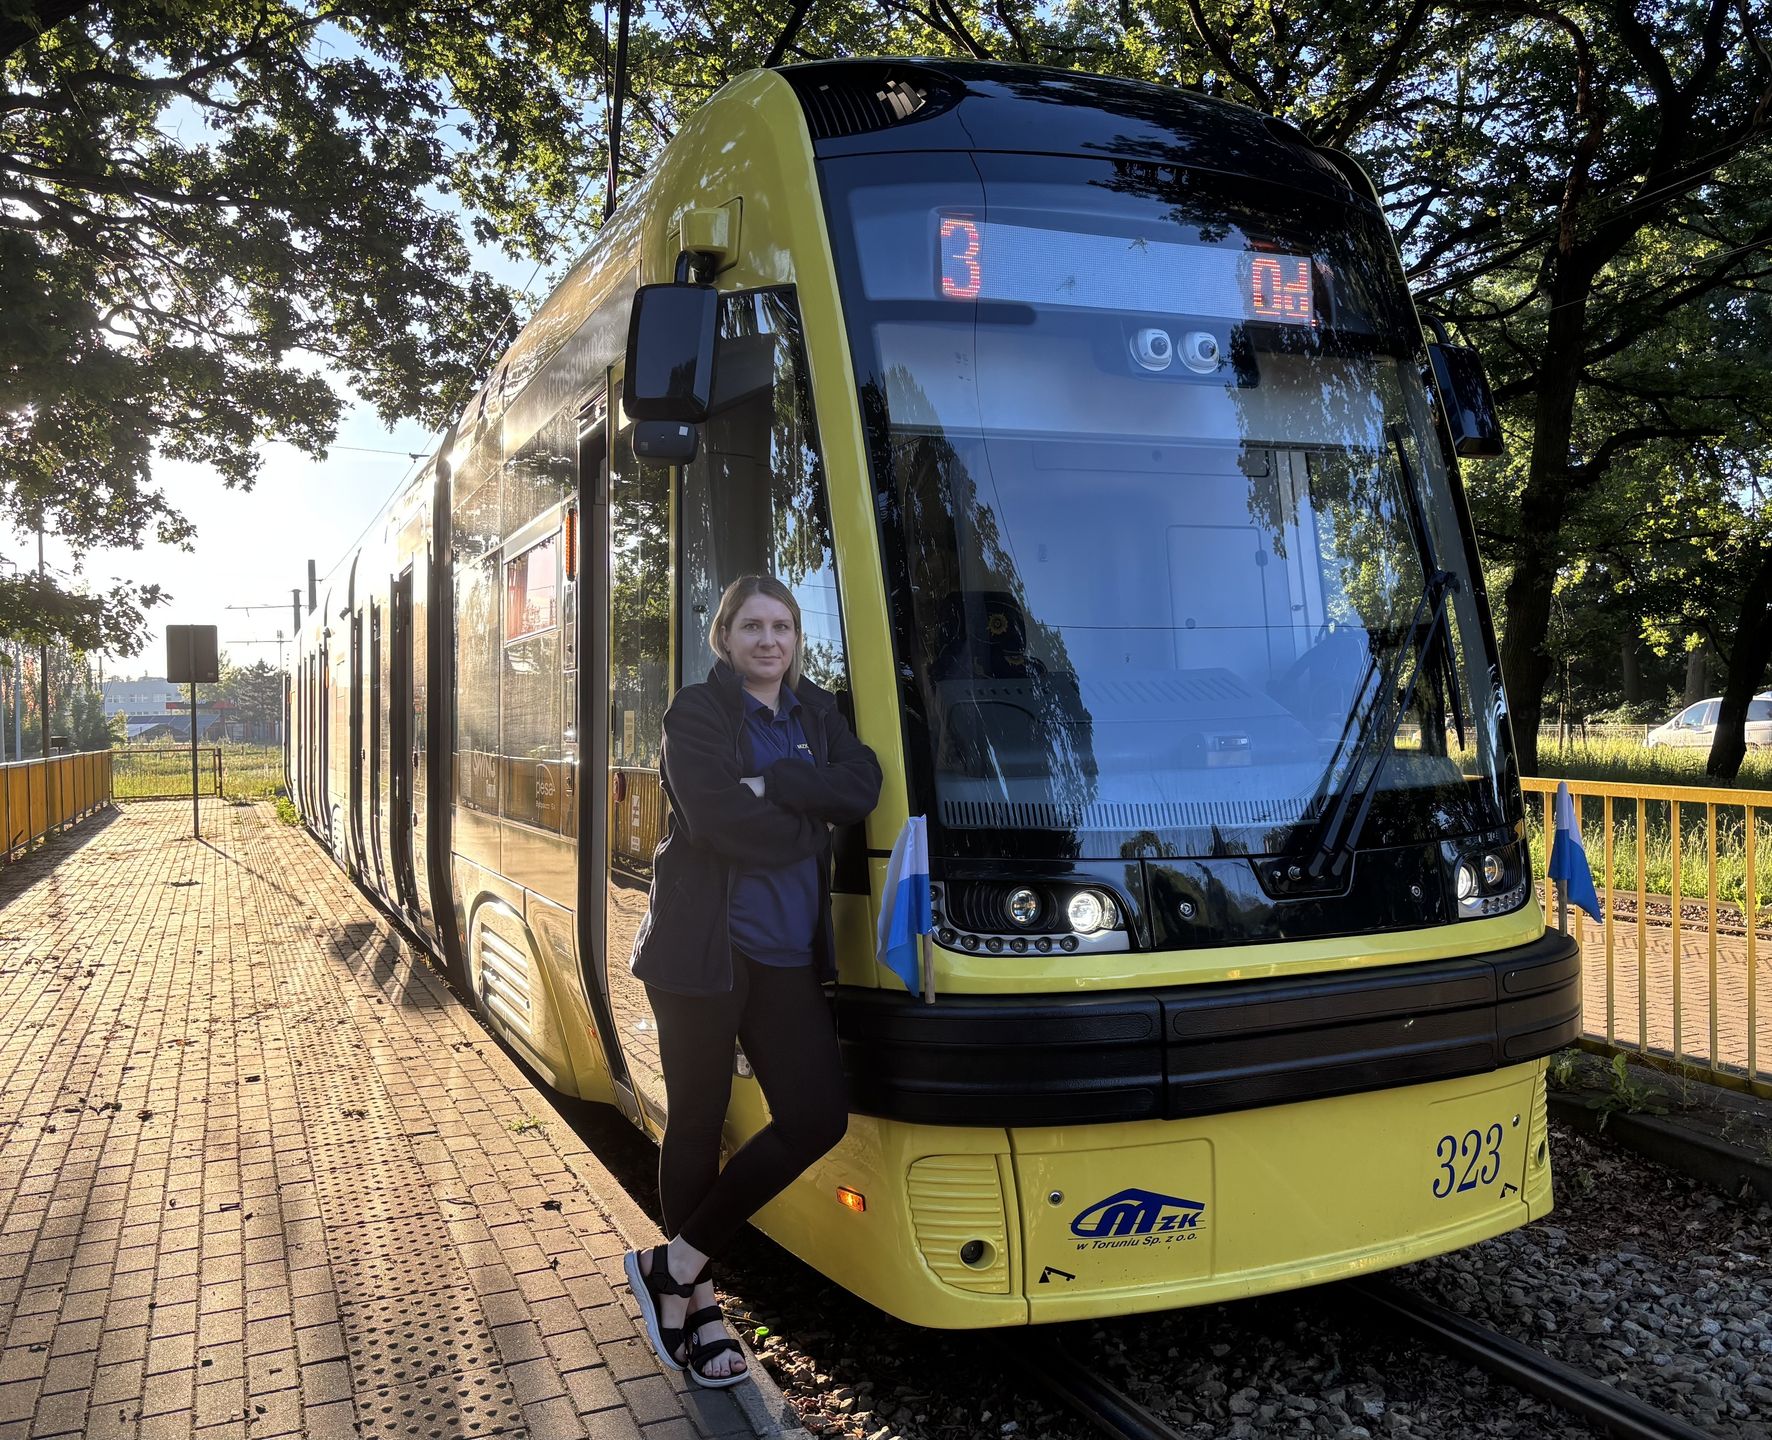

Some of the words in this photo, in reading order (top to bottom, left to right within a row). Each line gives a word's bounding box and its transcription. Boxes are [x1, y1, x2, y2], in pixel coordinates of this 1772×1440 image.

[941, 219, 980, 297] 3
[1432, 1123, 1503, 1199] 323
[1076, 1242, 1088, 1250] w
[1092, 1238, 1140, 1250] Toruniu
[1143, 1236, 1161, 1246] Sp.
[1165, 1235, 1174, 1243] z
[1176, 1233, 1197, 1242] o.o.
